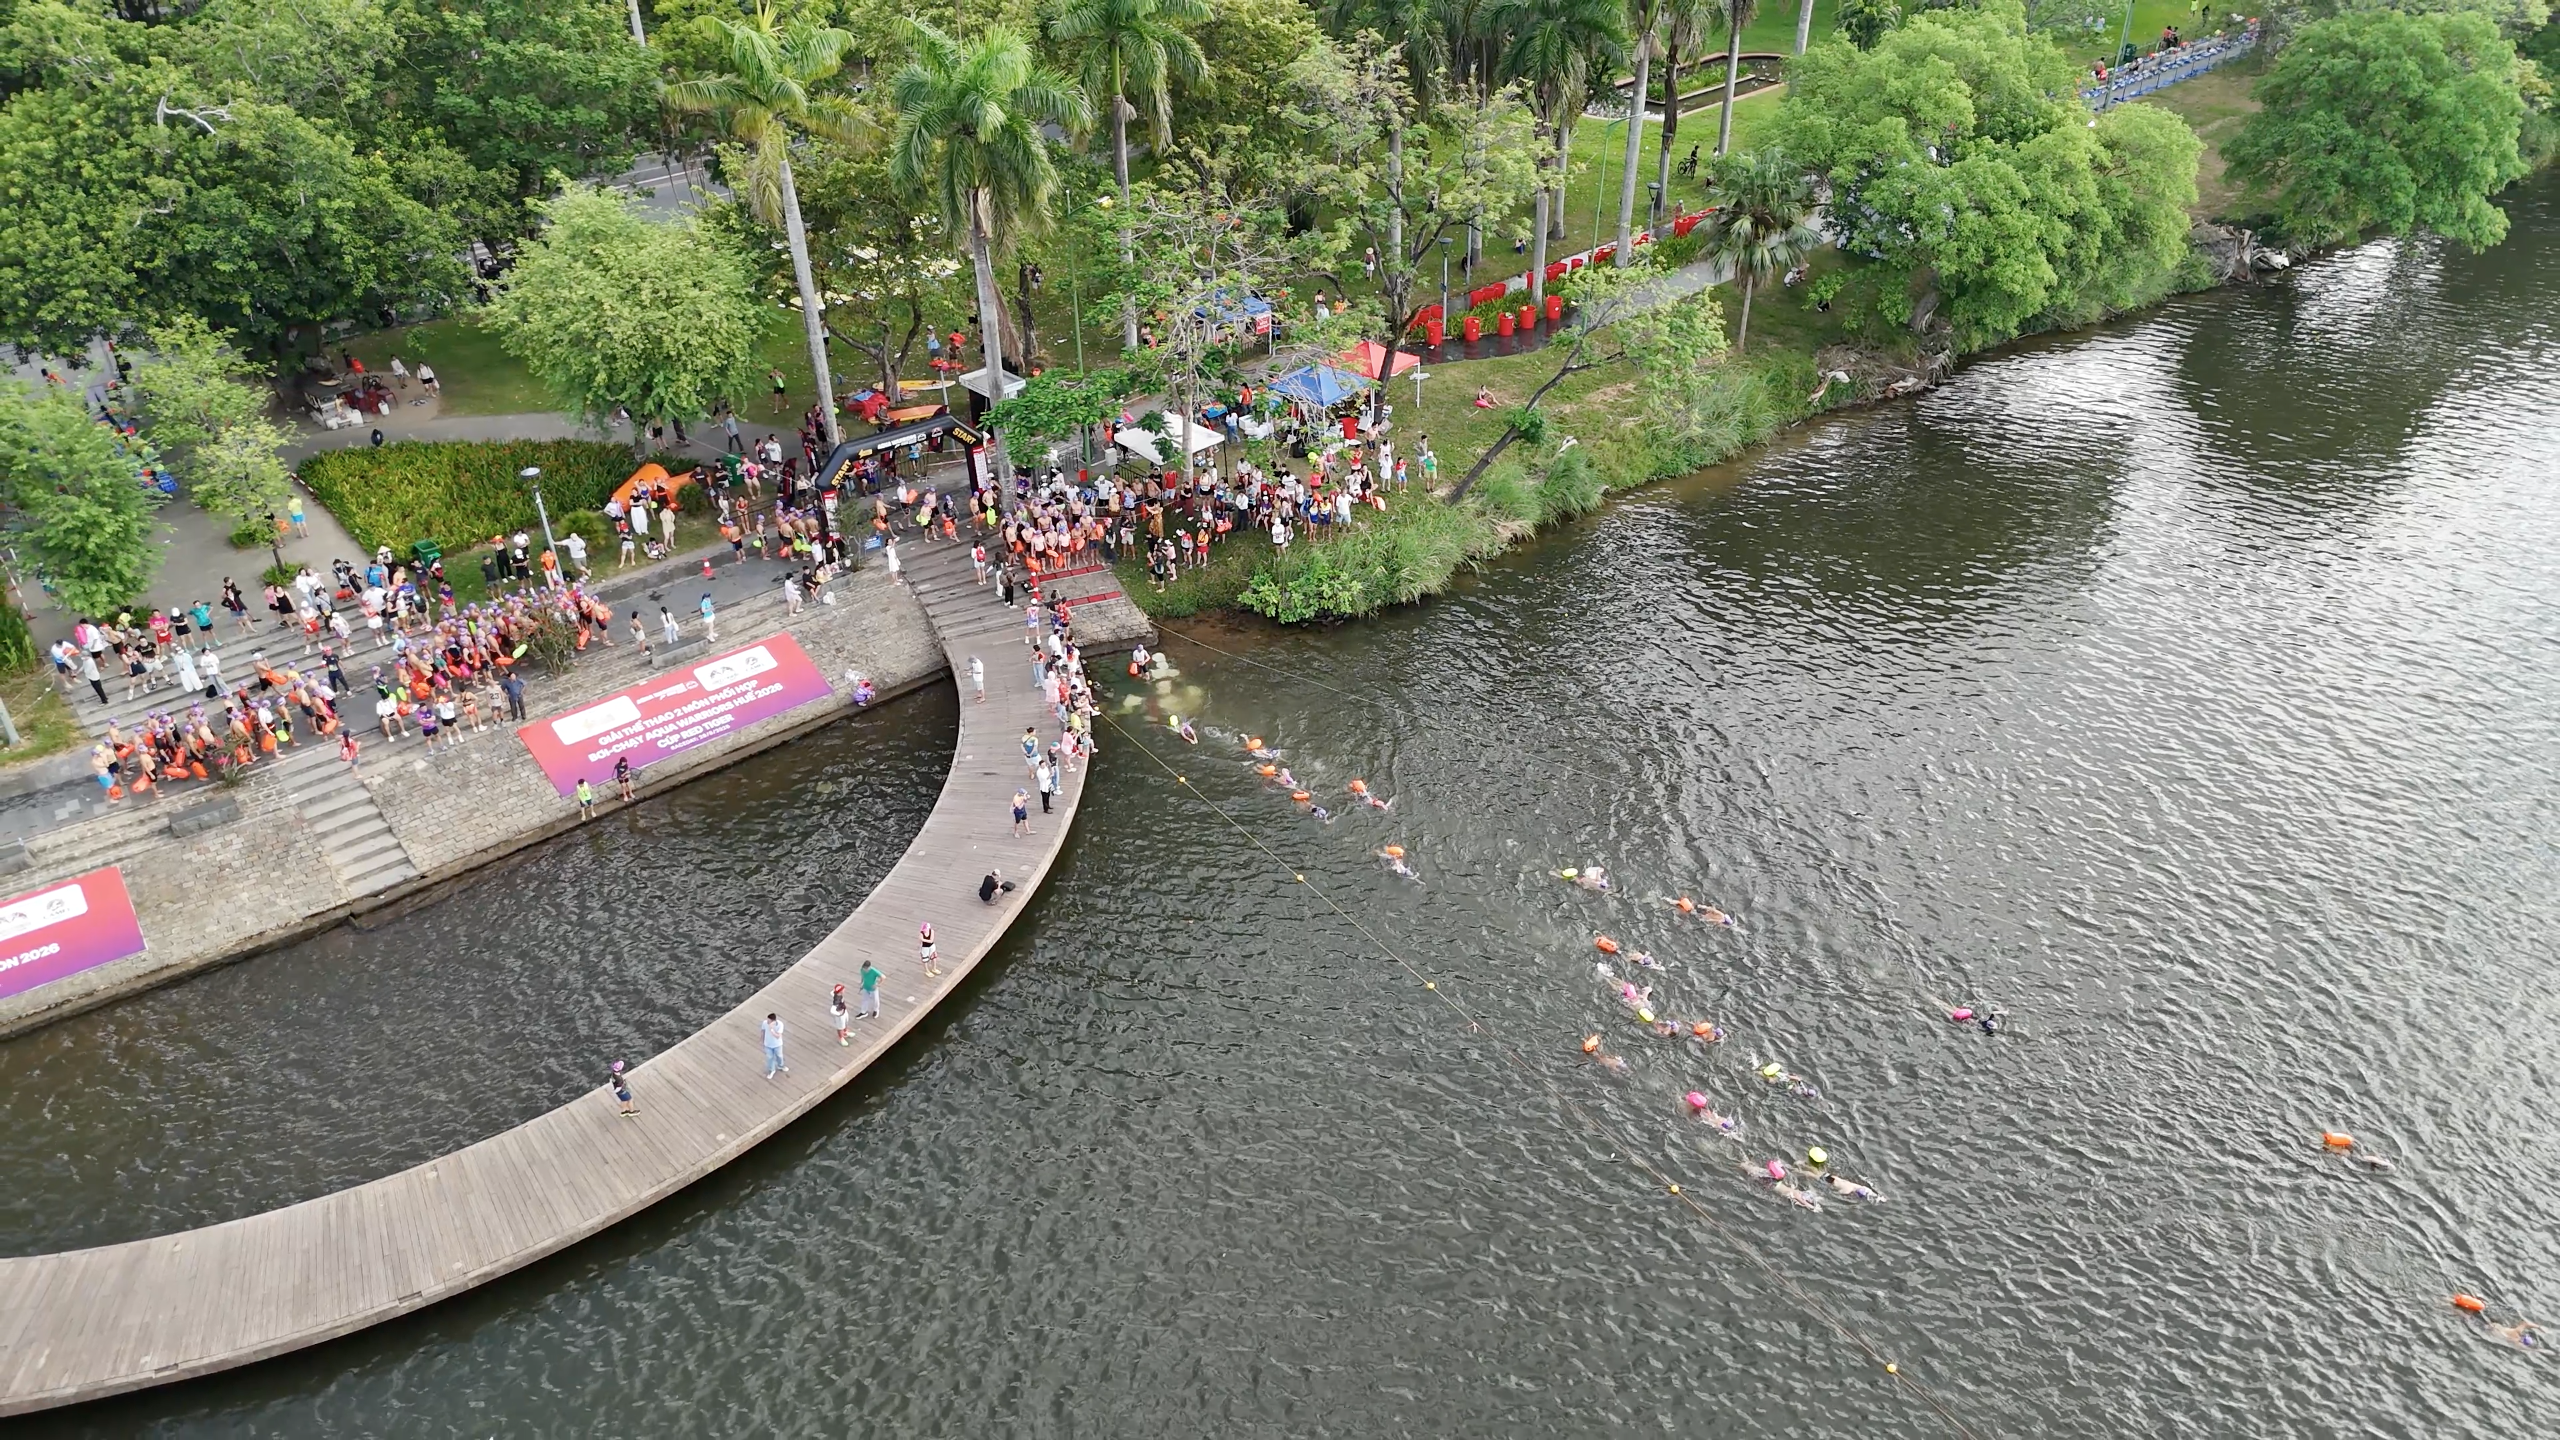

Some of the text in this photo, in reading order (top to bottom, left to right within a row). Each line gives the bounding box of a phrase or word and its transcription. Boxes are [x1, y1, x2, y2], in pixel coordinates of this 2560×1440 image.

[952, 427, 976, 445] START
[831, 459, 852, 487] START
[643, 711, 675, 728] THAO
[674, 708, 684, 717] 2
[681, 698, 710, 714] MÔN
[708, 687, 736, 704] PHỐI
[645, 723, 679, 741] AQUA
[676, 701, 735, 728] WARRIORS
[733, 690, 756, 706] HUẾ
[754, 683, 783, 699] 2026
[657, 713, 734, 748] CÚP RED TIGER
[19, 943, 60, 965] 2026
